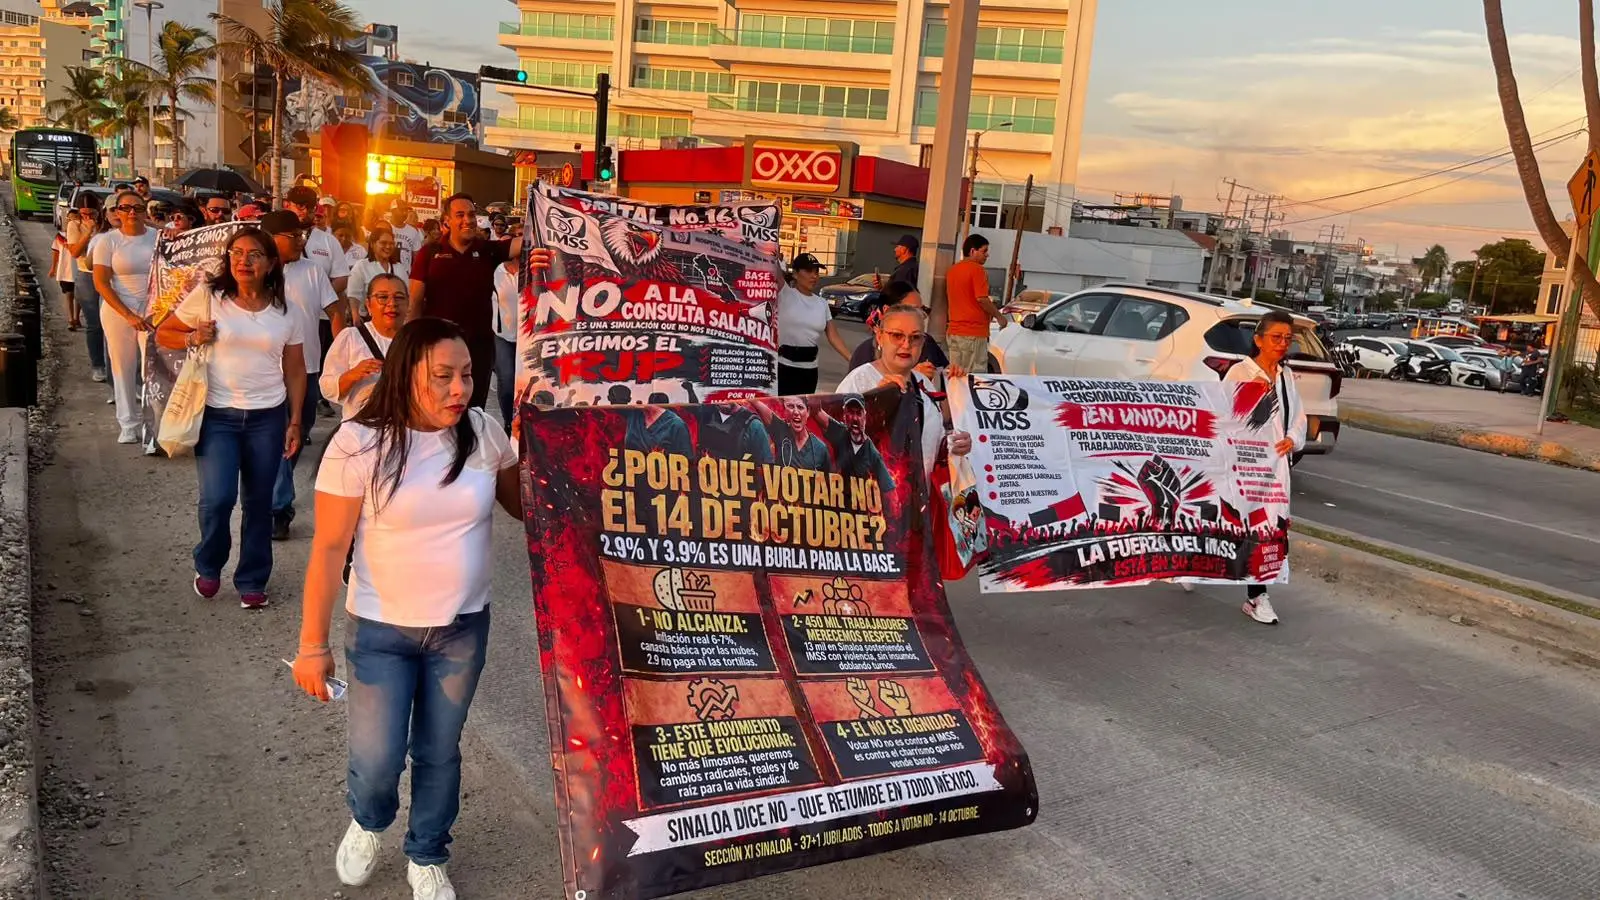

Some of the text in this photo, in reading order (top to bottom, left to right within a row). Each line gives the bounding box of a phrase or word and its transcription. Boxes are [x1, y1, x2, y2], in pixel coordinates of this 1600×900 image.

[755, 150, 837, 181] OXXO
[705, 208, 733, 224] 16
[196, 226, 229, 245] SOMOS
[547, 229, 589, 251] IMSS
[742, 223, 778, 243] IMSS
[745, 271, 770, 280] BASE
[535, 281, 621, 325] NO
[644, 284, 698, 305] A LA
[747, 289, 777, 299] UNIDA
[576, 320, 745, 343] ES UNA SIMULACIÓN QUE NO NOS REPRESENTA
[621, 301, 777, 349] CONSULTA SALARIAL
[541, 335, 682, 359] EXIGIMOS EL
[551, 351, 685, 385] RJP
[711, 356, 744, 364] PENSIONES
[744, 373, 771, 381] NUESTROS
[1043, 381, 1201, 399] TRABAJADORES JUBILADOS,
[1062, 390, 1196, 407] PENSIONADOS Y ACTIVOS
[975, 411, 1031, 431] IMSS
[1081, 405, 1197, 433] ¡EN UNIDAD!
[1070, 431, 1213, 448] POR LA DEFENSA DERECHOS LOS
[1079, 441, 1211, 457] TRABAJADORES SEGURO SOCIAL
[602, 448, 883, 514] ¿POR QUÉ VOTAR NO
[1000, 489, 1059, 498] RESPETO NUESTROS
[601, 489, 887, 551] EL 14 DE OCTUBRE?
[600, 533, 901, 573] 2.9% Y 3.9% ES UNA BURLA PARA LA BASE.
[1077, 545, 1105, 568] LA
[1106, 535, 1169, 560] FUERZA
[1171, 535, 1201, 554] DEL
[1114, 554, 1146, 577] ESTÁ
[653, 610, 748, 633] NO ALCANZA:
[805, 616, 909, 630] 450 MIL TRABAJADORES
[655, 630, 737, 646] Inflación real 6-7%,
[806, 629, 905, 643] MERECEMOS RESPETO:
[640, 641, 759, 659] canasta básica por las nubes,
[804, 642, 863, 651] 13 Sinaloa
[806, 651, 827, 661] IMSS
[647, 653, 758, 669] 2.9 no paga las tortillas.
[655, 718, 781, 743] 3- ESTE MOVIMIENTO
[852, 714, 960, 738] EL NO ES DIGNIDAD:
[650, 734, 796, 761] TIENE QUE EVOLUCIONAR:
[847, 732, 960, 750] Votar NO contra IMSS,
[866, 742, 964, 760] contra charrismo nos
[662, 750, 793, 774] No más limosnas, queremos
[890, 759, 914, 769] vende
[660, 759, 799, 787] cambios radicales, reales de
[678, 774, 790, 798] raíz para la vida sindical.
[667, 769, 980, 843] SINALOA DICE NO QUE RETUMBE EN TODO MÉXICO.
[704, 811, 947, 867] SECCIÓN XI SINALOA 37+1 JUBILADOS TODOS A VOTAR NO 14
